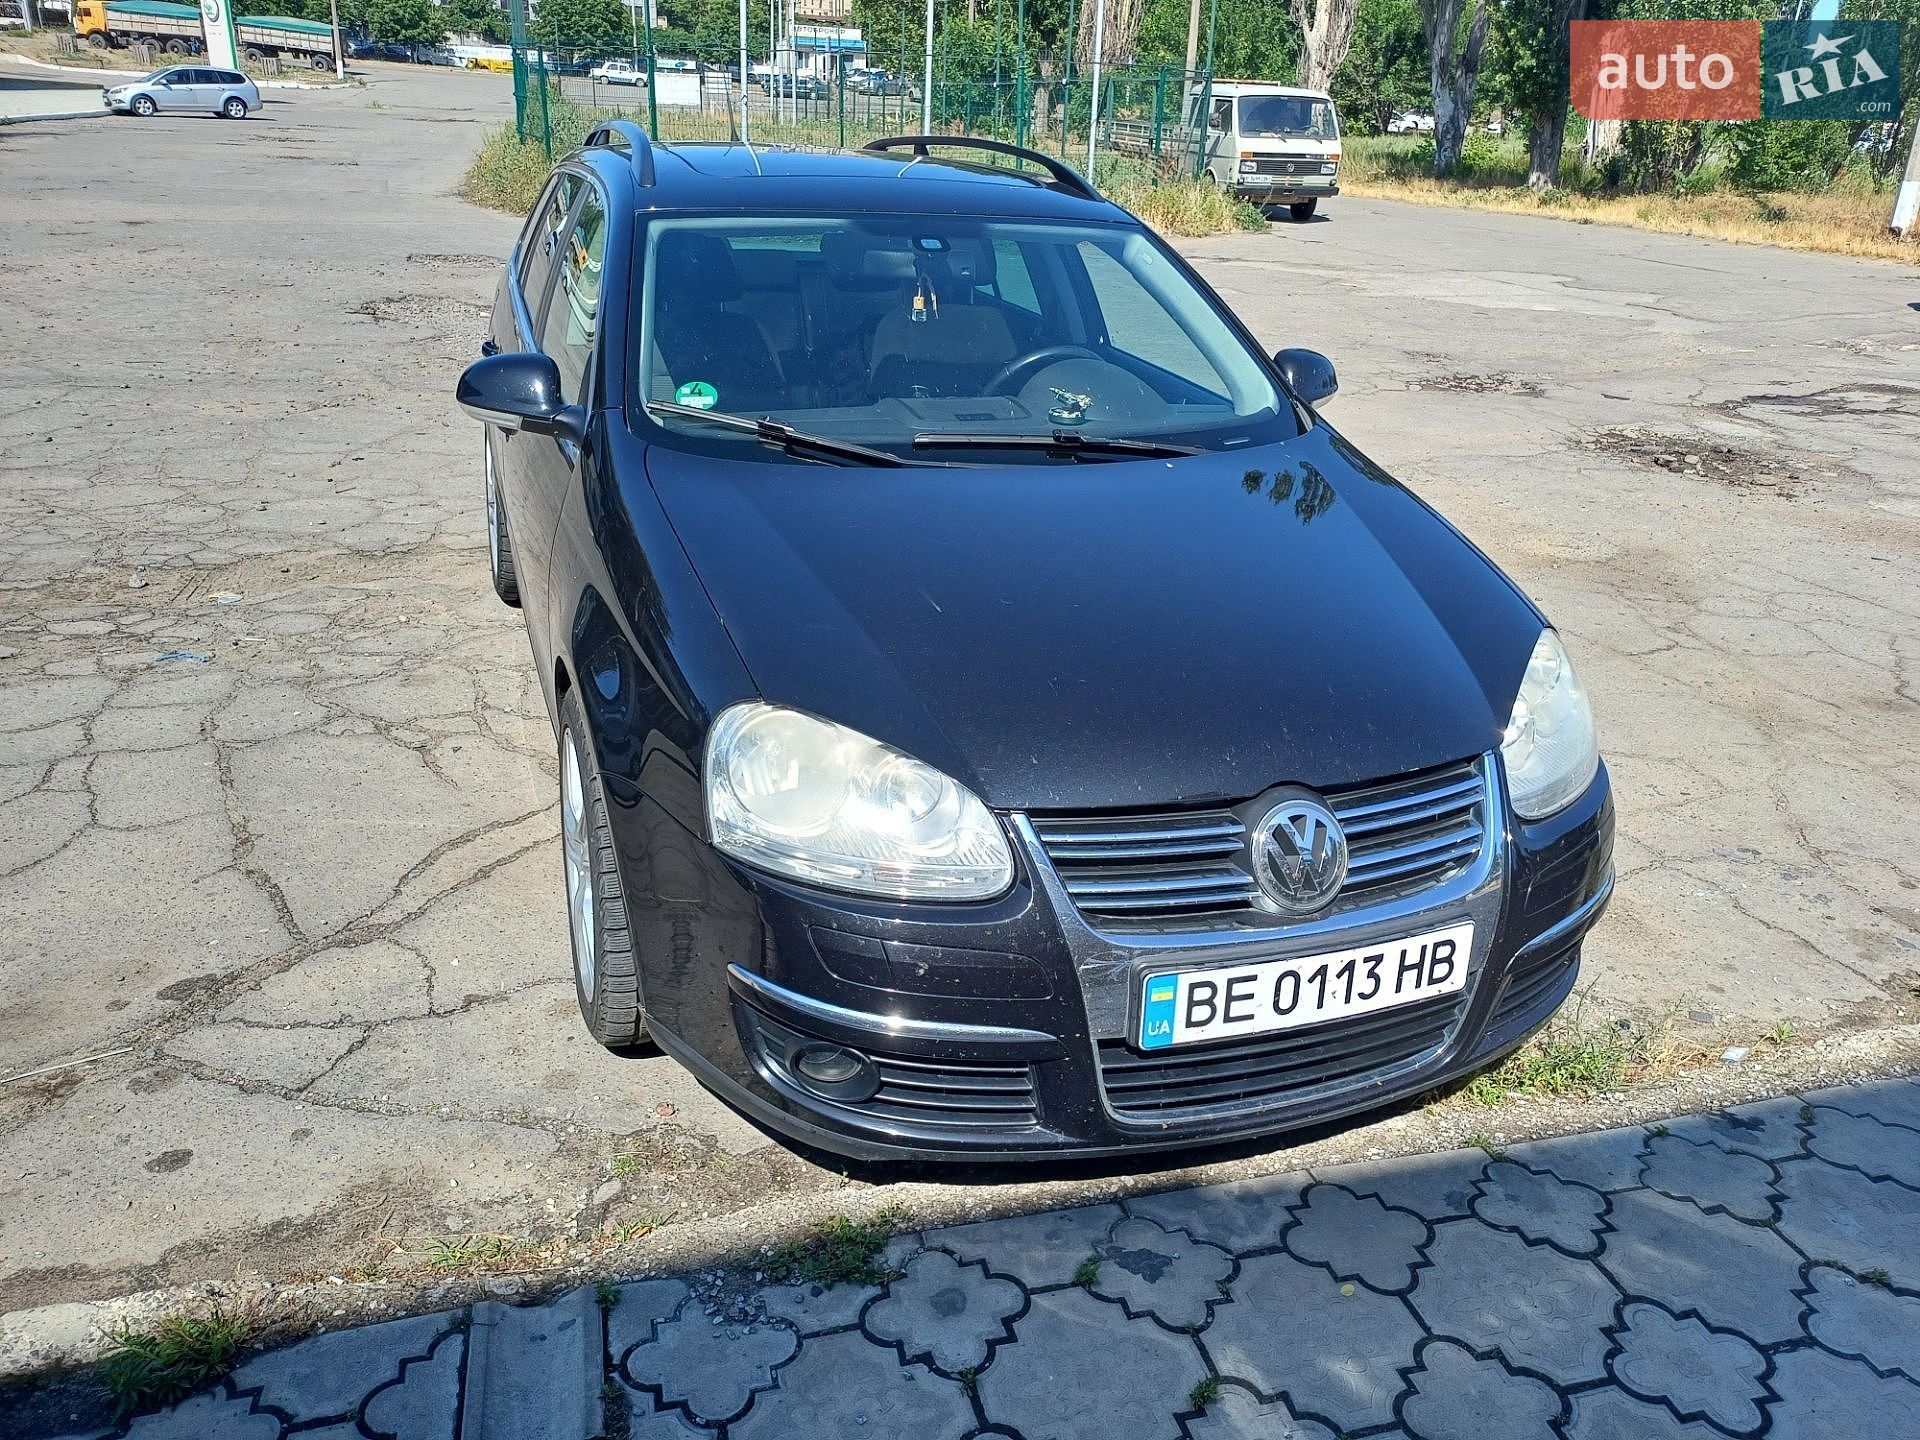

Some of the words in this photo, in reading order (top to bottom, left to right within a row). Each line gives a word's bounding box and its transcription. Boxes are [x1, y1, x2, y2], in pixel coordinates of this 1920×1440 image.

[690, 383, 703, 396] 4
[1185, 974, 1258, 1029] BE
[1273, 953, 1384, 1016] 0113
[1395, 939, 1457, 994] HB
[1147, 1019, 1171, 1037] UA
